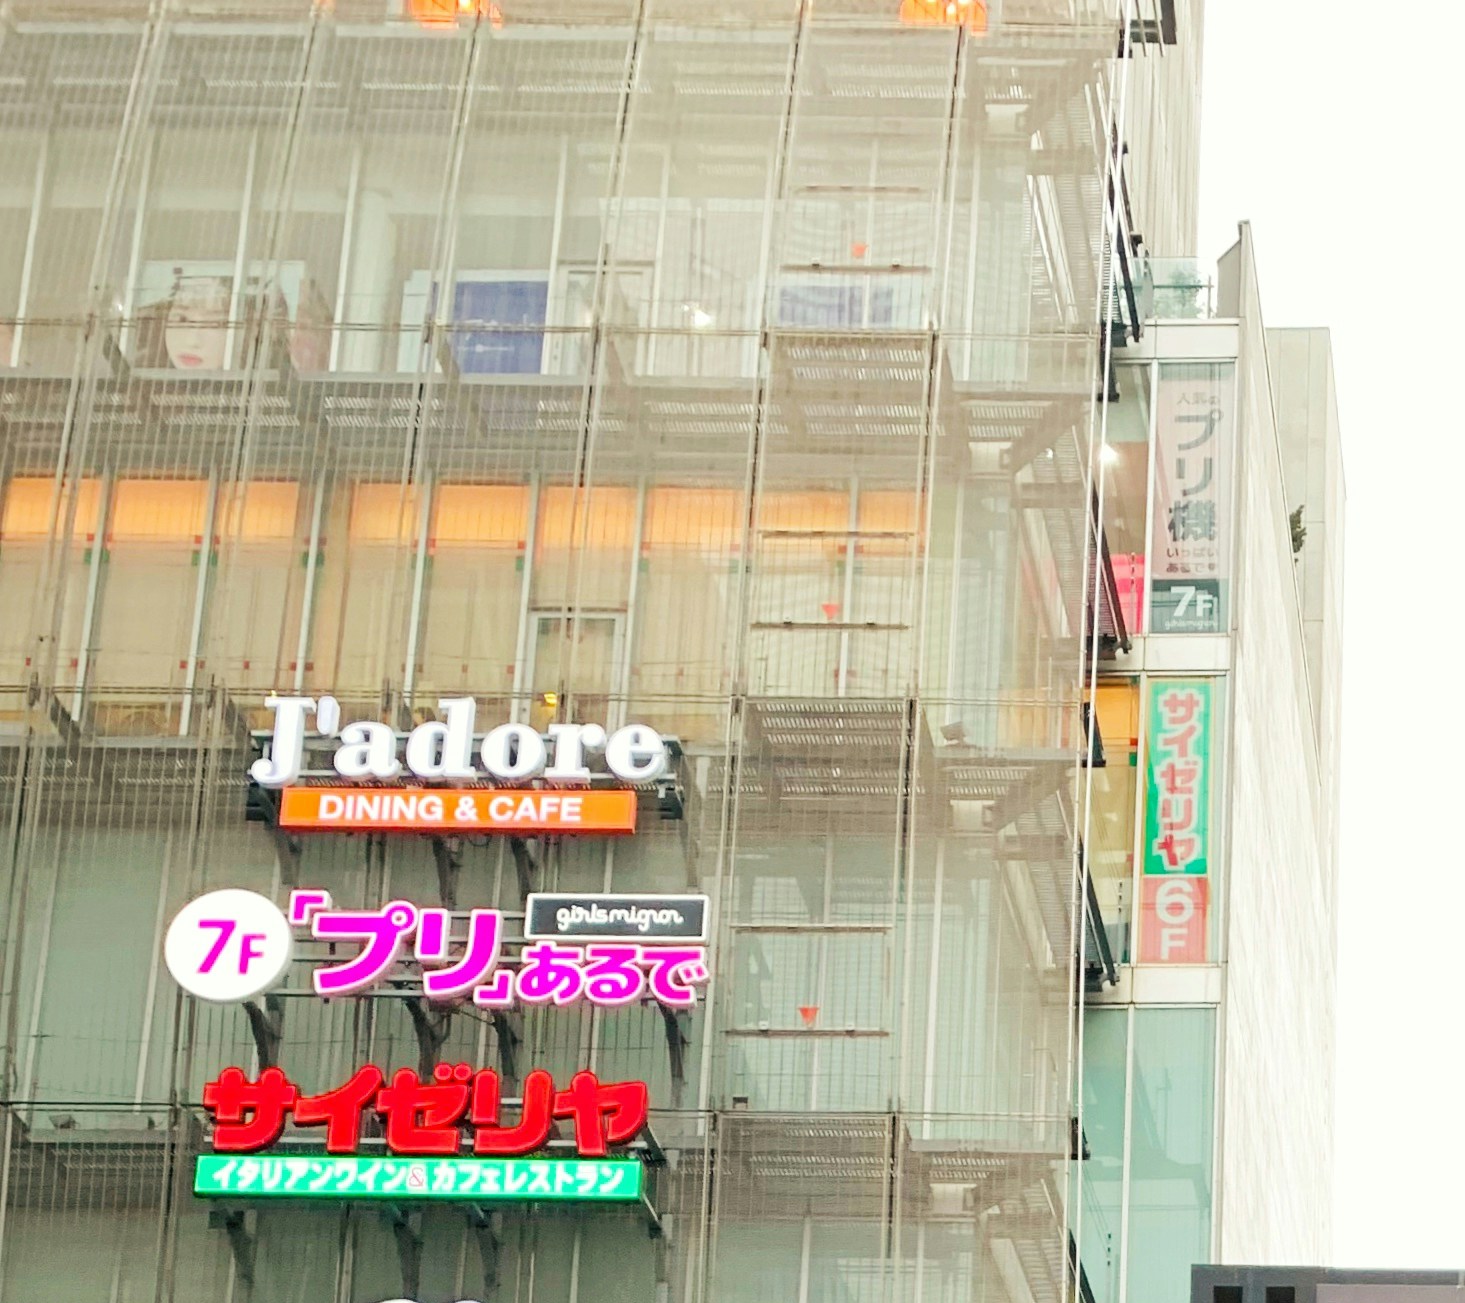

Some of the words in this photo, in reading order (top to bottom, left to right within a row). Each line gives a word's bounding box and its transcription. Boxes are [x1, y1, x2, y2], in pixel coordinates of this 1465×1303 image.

[1166, 408, 1224, 542] プリ機
[1170, 586, 1215, 617] 7F
[251, 695, 666, 788] J'adore
[1155, 690, 1203, 870] サイゼリヤ
[318, 795, 444, 822] DINING
[454, 796, 479, 821] &
[488, 795, 583, 822] CAFE
[195, 917, 267, 976] 7F
[203, 1063, 649, 1155] サイゼリヤ
